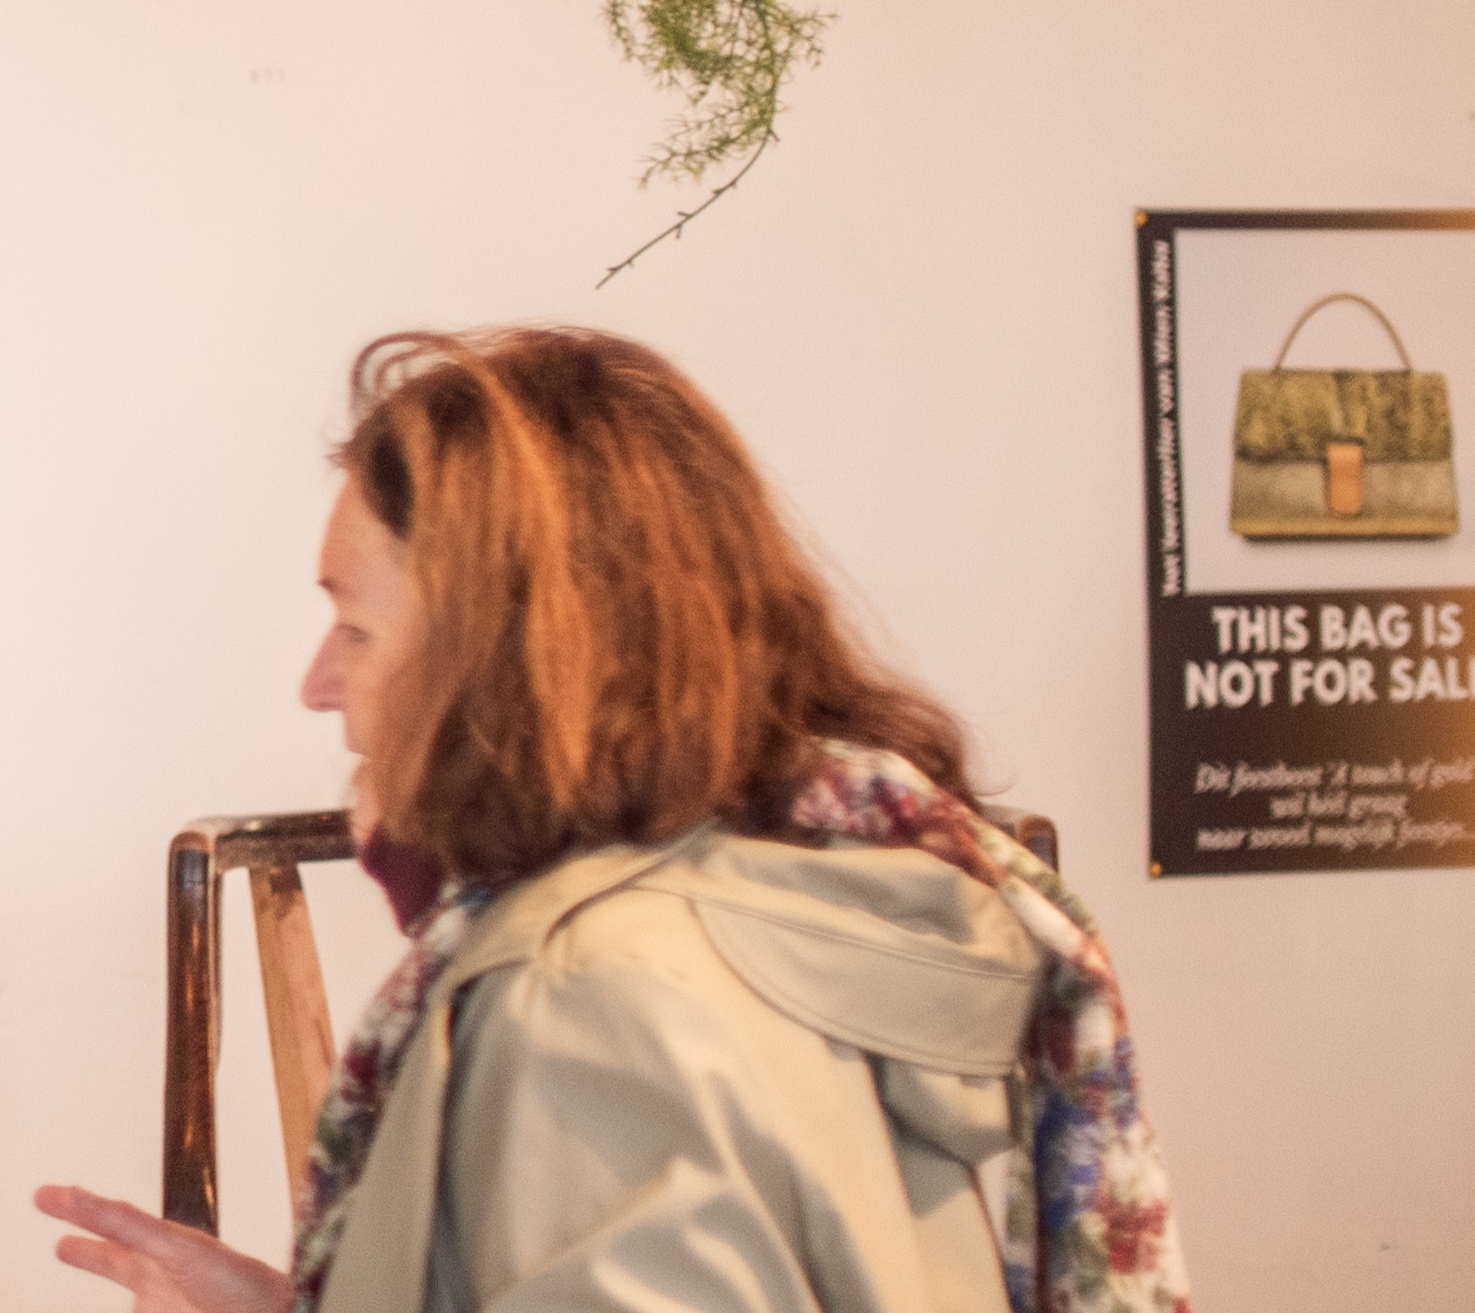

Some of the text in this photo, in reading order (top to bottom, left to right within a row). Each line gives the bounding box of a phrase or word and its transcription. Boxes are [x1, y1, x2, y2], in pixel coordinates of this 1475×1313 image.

[1211, 602, 1464, 654] THIS BAG IS
[1184, 660, 1279, 709] NOT
[1290, 657, 1377, 706] FOR
